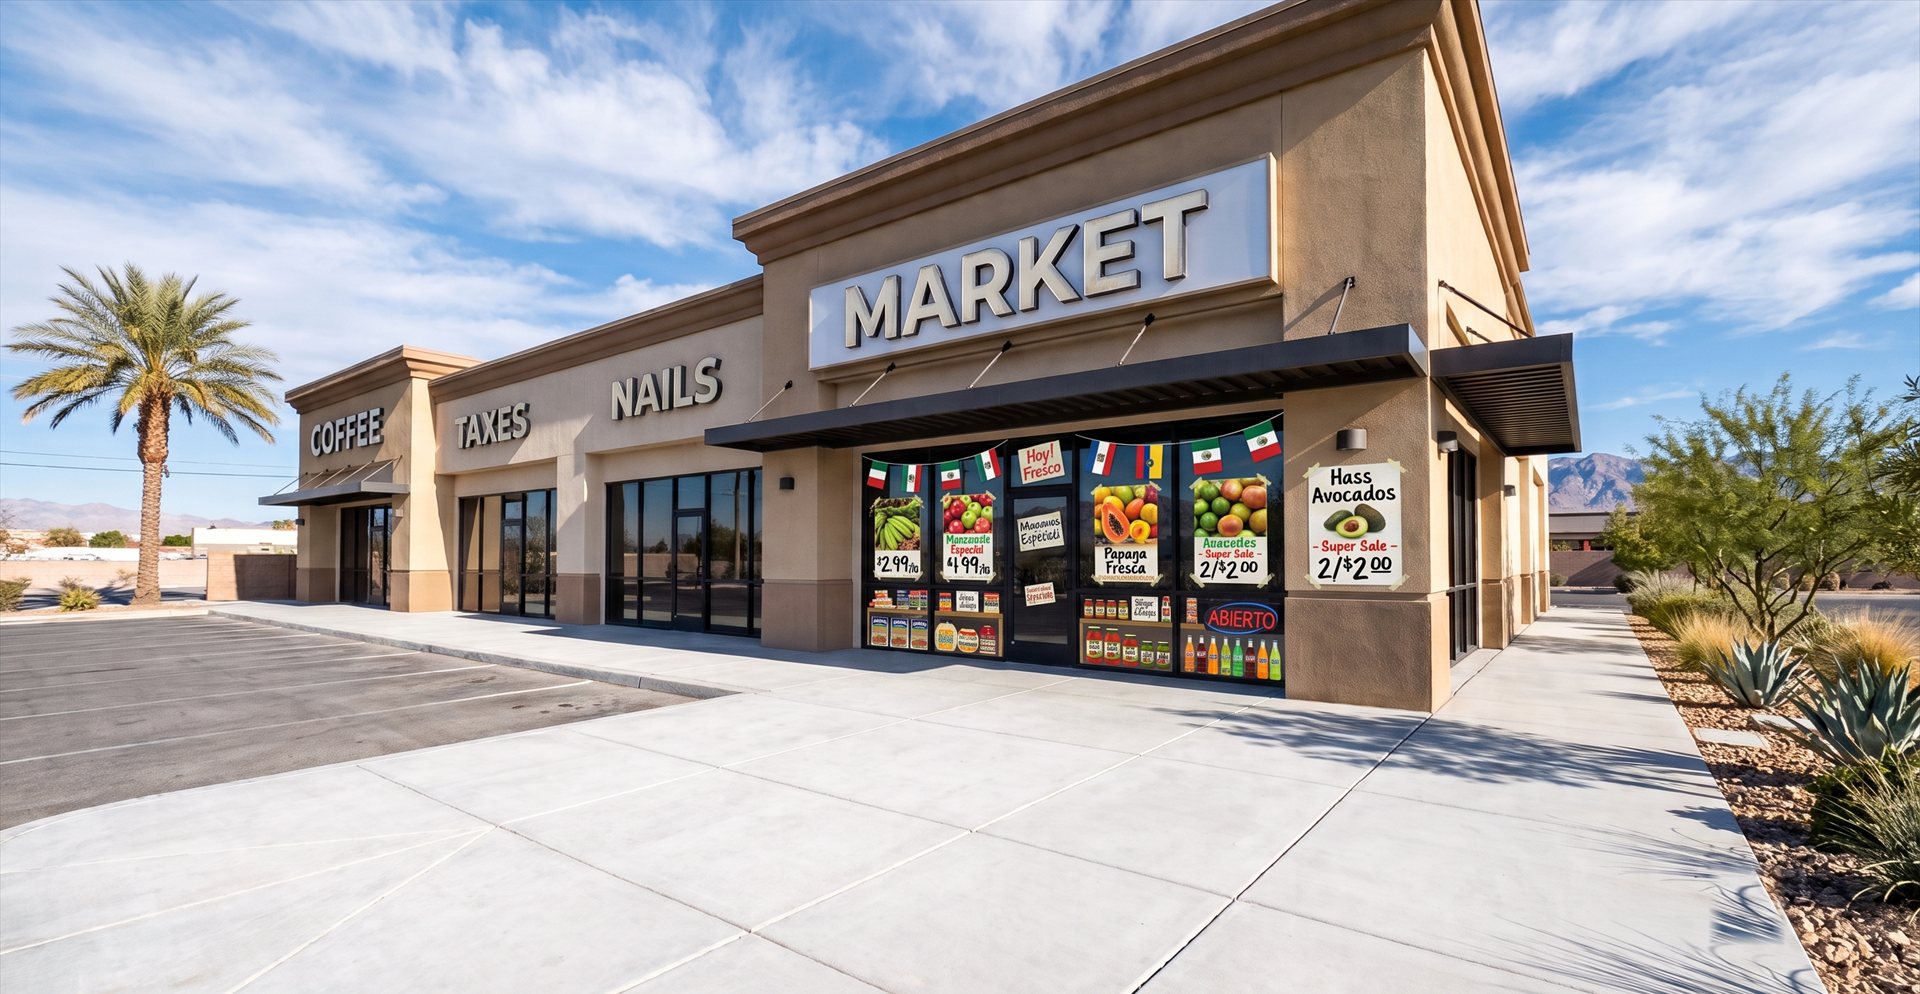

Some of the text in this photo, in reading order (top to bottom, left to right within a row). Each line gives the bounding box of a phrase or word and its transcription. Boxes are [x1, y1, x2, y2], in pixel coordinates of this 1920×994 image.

[845, 188, 1209, 348] MARKET
[611, 356, 722, 421] NAILS
[310, 407, 384, 457] COFFEE
[455, 402, 530, 449] TAXES
[1027, 443, 1054, 466] Hoy!
[1023, 463, 1061, 481] Fresco
[1331, 467, 1372, 486] Hass
[1312, 484, 1396, 504] Avocados
[1205, 549, 1255, 560] Super Sale
[1321, 540, 1387, 555] Super Sale
[1106, 560, 1147, 575] Fresca
[1207, 609, 1275, 630] ABIERTO
